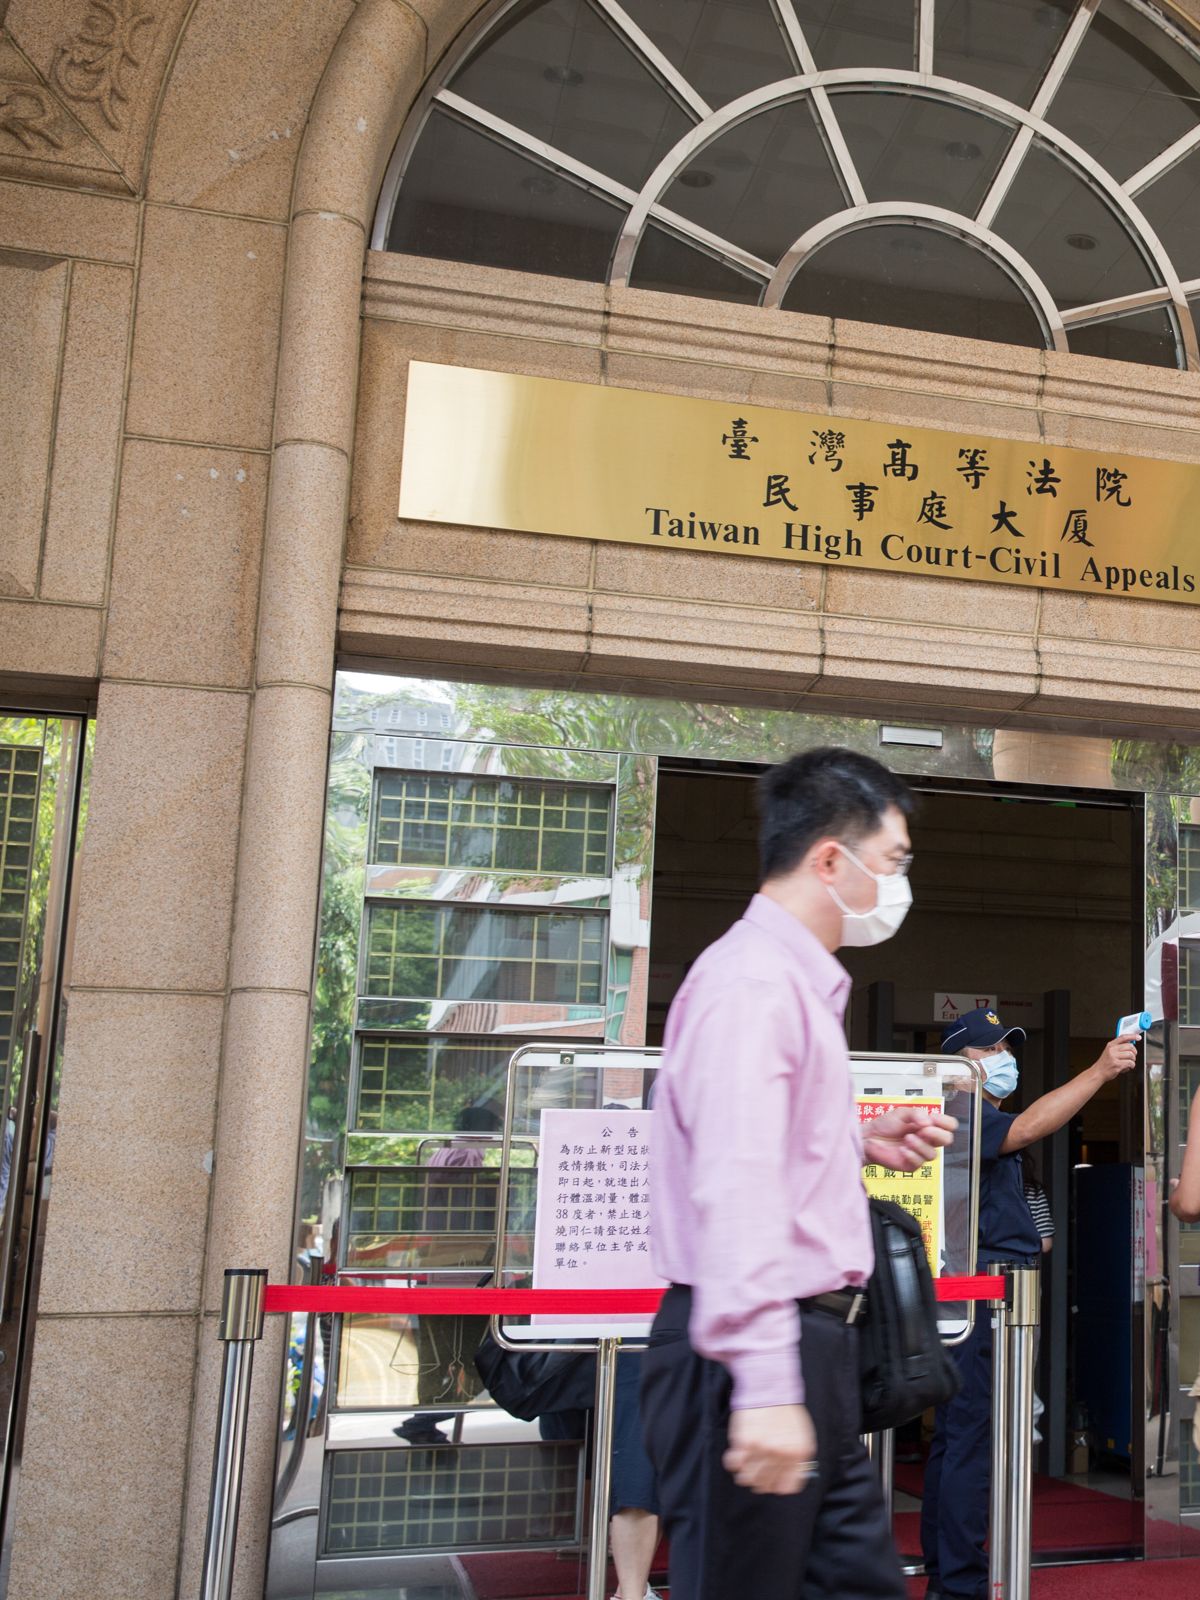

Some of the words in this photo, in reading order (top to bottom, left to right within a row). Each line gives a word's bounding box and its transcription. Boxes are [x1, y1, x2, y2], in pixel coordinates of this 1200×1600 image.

[645, 507, 760, 546] Taiwan
[782, 522, 863, 560] High
[880, 533, 1061, 579] Court-Civil
[1080, 557, 1195, 593] Appeals
[601, 1126, 639, 1138] 公告
